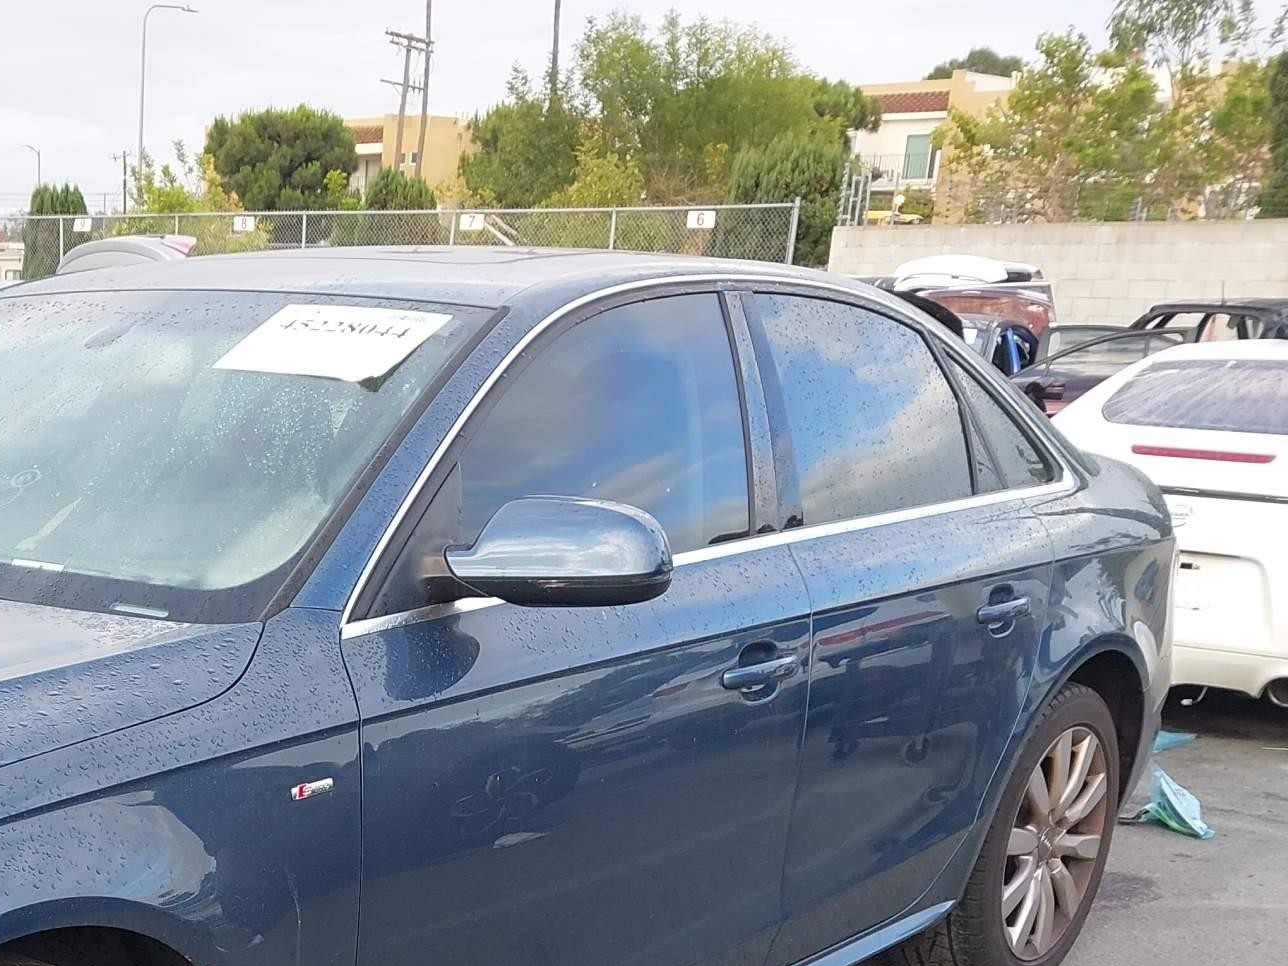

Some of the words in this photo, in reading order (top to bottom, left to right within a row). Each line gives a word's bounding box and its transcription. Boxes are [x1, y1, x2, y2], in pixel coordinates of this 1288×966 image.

[241, 217, 247, 229] 8
[469, 215, 476, 228] 7
[697, 212, 704, 226] 6
[279, 319, 411, 339] 45228044
